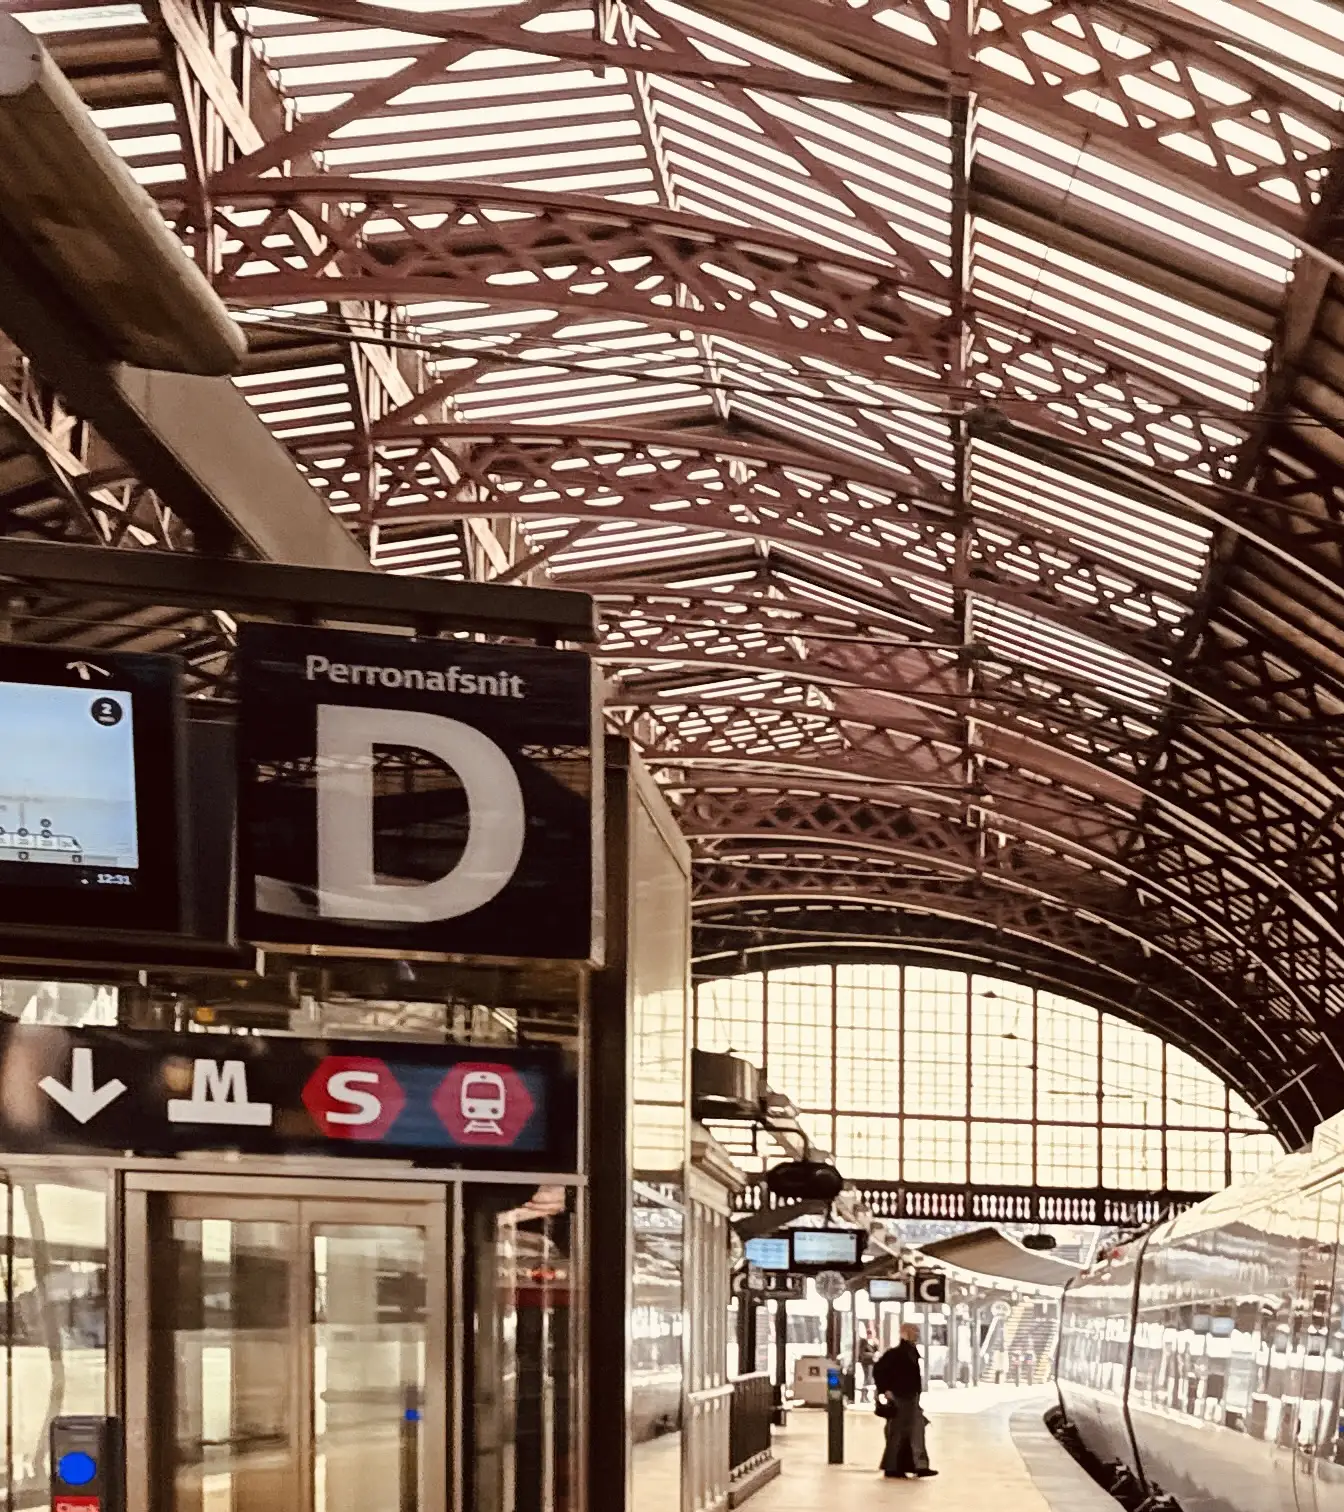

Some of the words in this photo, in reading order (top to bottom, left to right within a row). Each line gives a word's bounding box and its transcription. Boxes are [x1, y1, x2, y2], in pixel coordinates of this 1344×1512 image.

[305, 653, 526, 700] Perronafsnit
[316, 703, 526, 923] D
[324, 1069, 384, 1126] S
[919, 1278, 940, 1303] C
